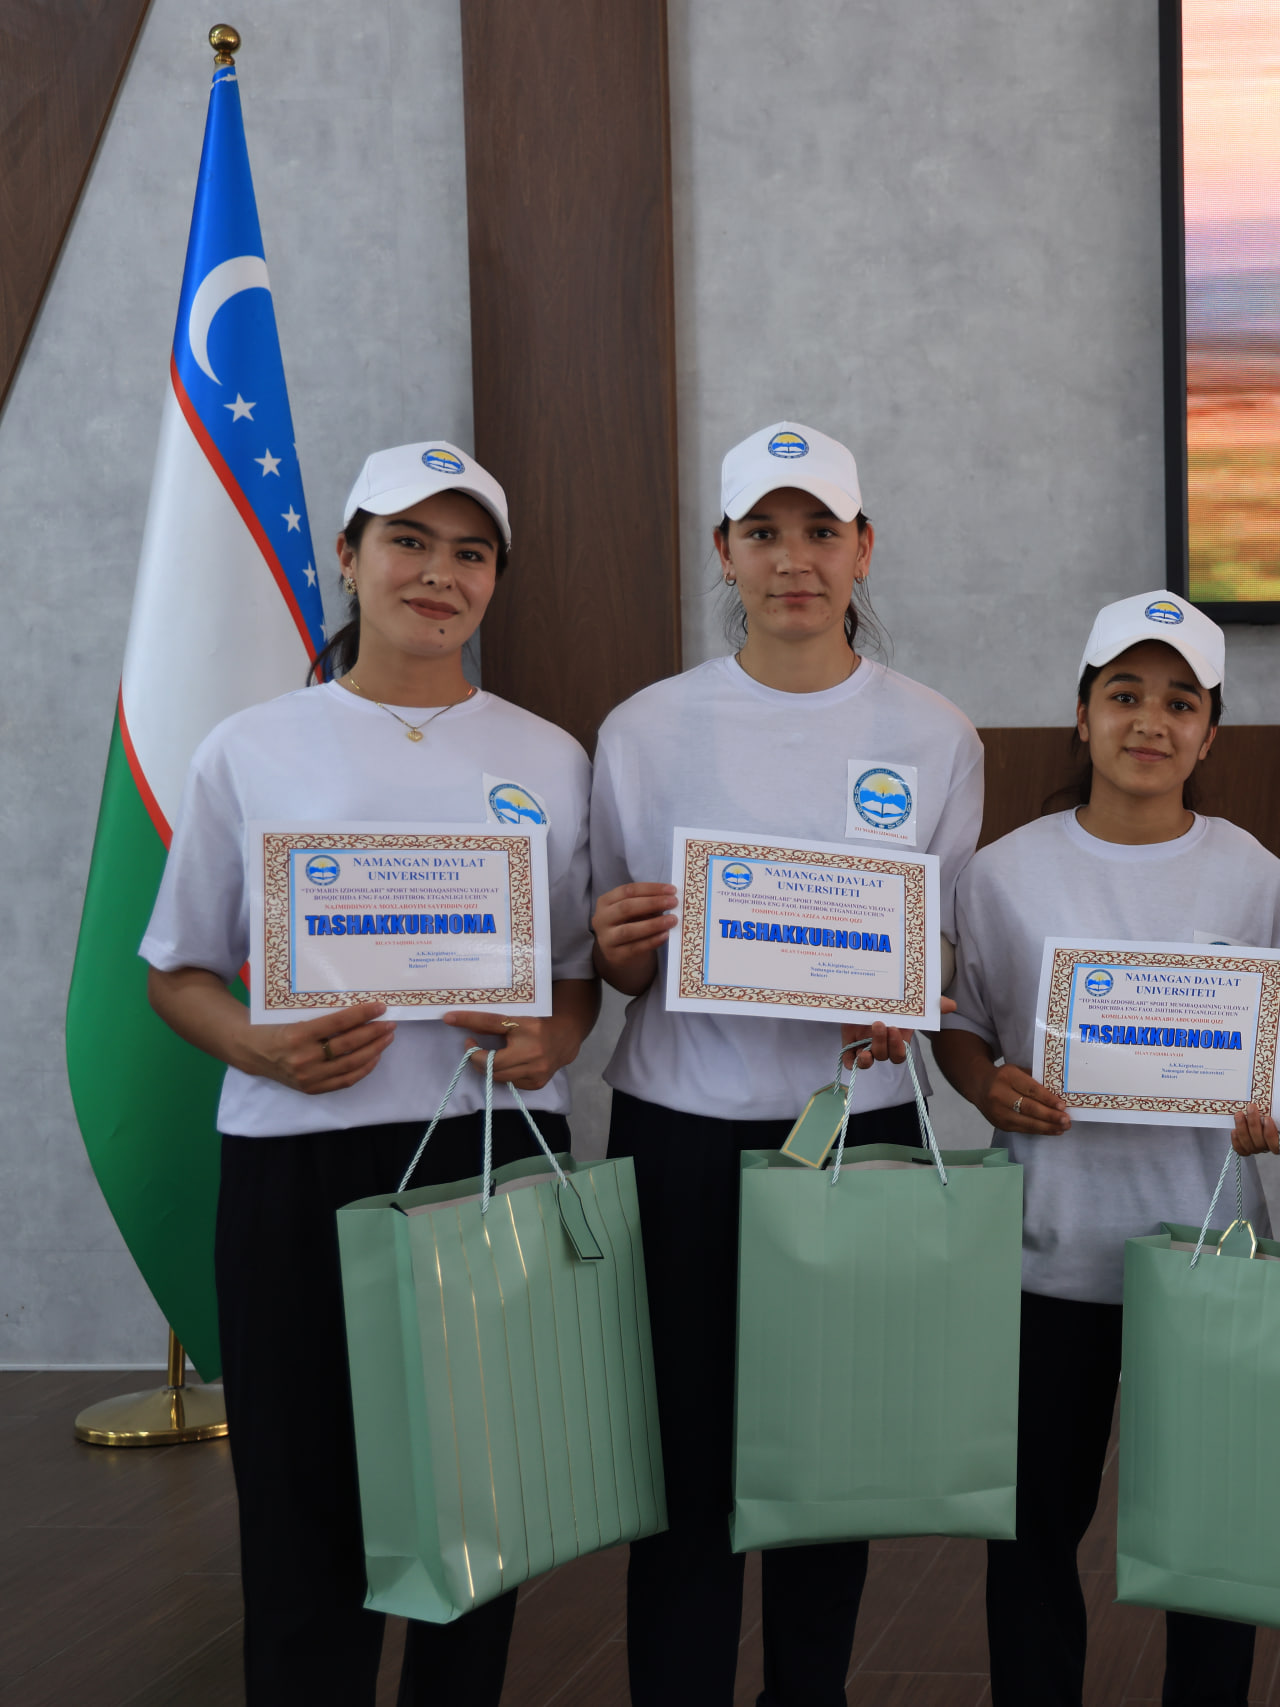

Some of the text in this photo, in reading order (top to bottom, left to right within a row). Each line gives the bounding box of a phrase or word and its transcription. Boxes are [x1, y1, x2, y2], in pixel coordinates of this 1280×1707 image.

[353, 857, 486, 868] NAMANGAN DAVLAT
[368, 871, 459, 881] UNIVERSITETI
[764, 867, 884, 888] NAMANGAN DAVLAT
[777, 881, 860, 898] UNIVERSITETI
[304, 913, 496, 936] TASHAKKURNOMA
[718, 918, 892, 953] TASHAKKURNOMA
[1124, 972, 1241, 987] NAMANGAN DAVLAT
[1135, 985, 1216, 998] UNIVERSITETI
[1077, 1023, 1244, 1050] TASHAKKURNOMA
